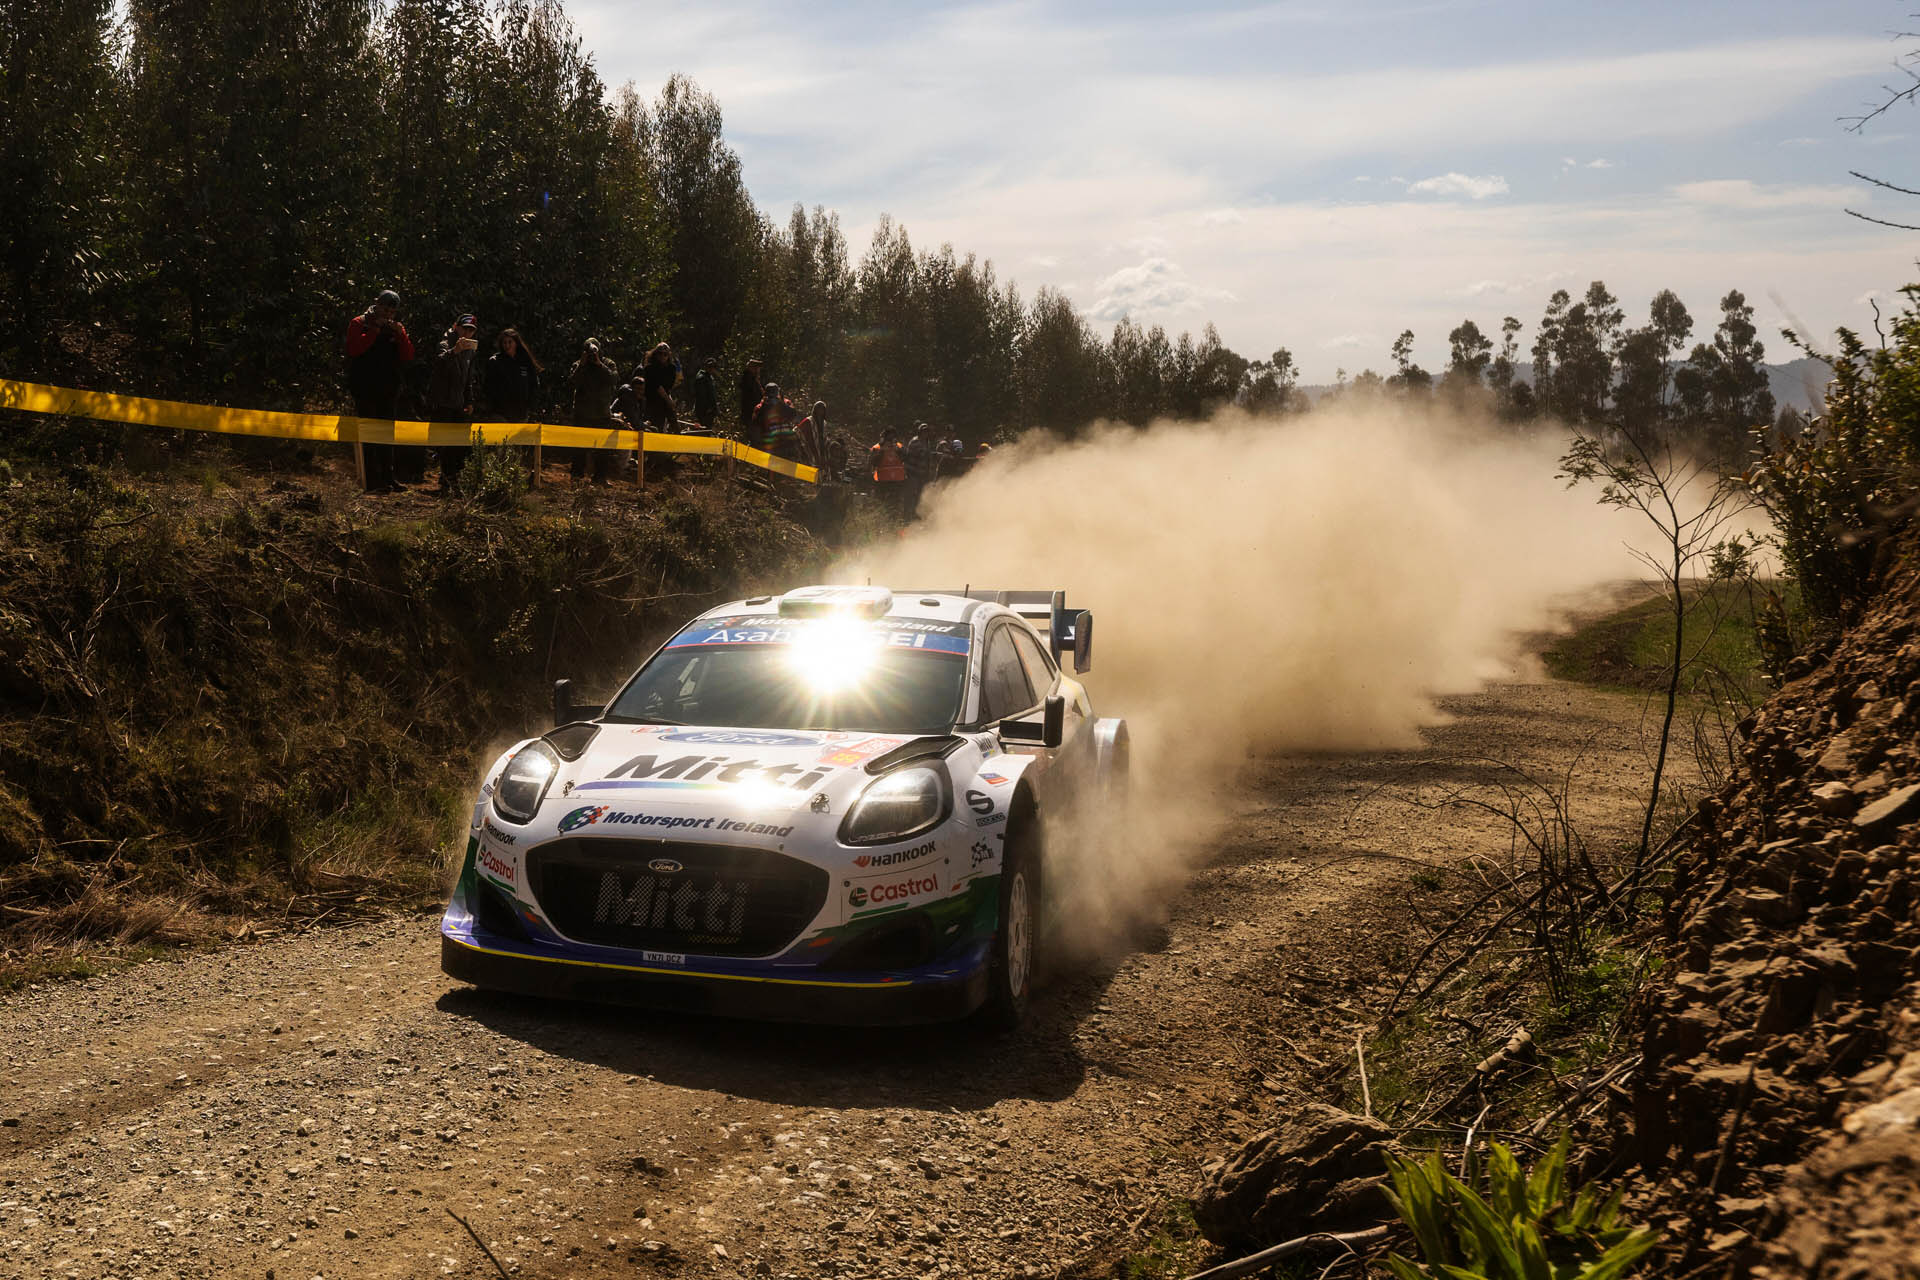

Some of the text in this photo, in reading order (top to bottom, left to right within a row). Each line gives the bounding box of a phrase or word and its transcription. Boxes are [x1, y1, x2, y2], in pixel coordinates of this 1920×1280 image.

[702, 628, 794, 643] Asah
[603, 754, 835, 791] Mitti
[602, 811, 795, 837] Motorsport Ireland
[482, 850, 515, 882] Castrol
[655, 861, 675, 871] Ford
[592, 871, 750, 934] Mitti
[870, 872, 939, 903] Castrol
